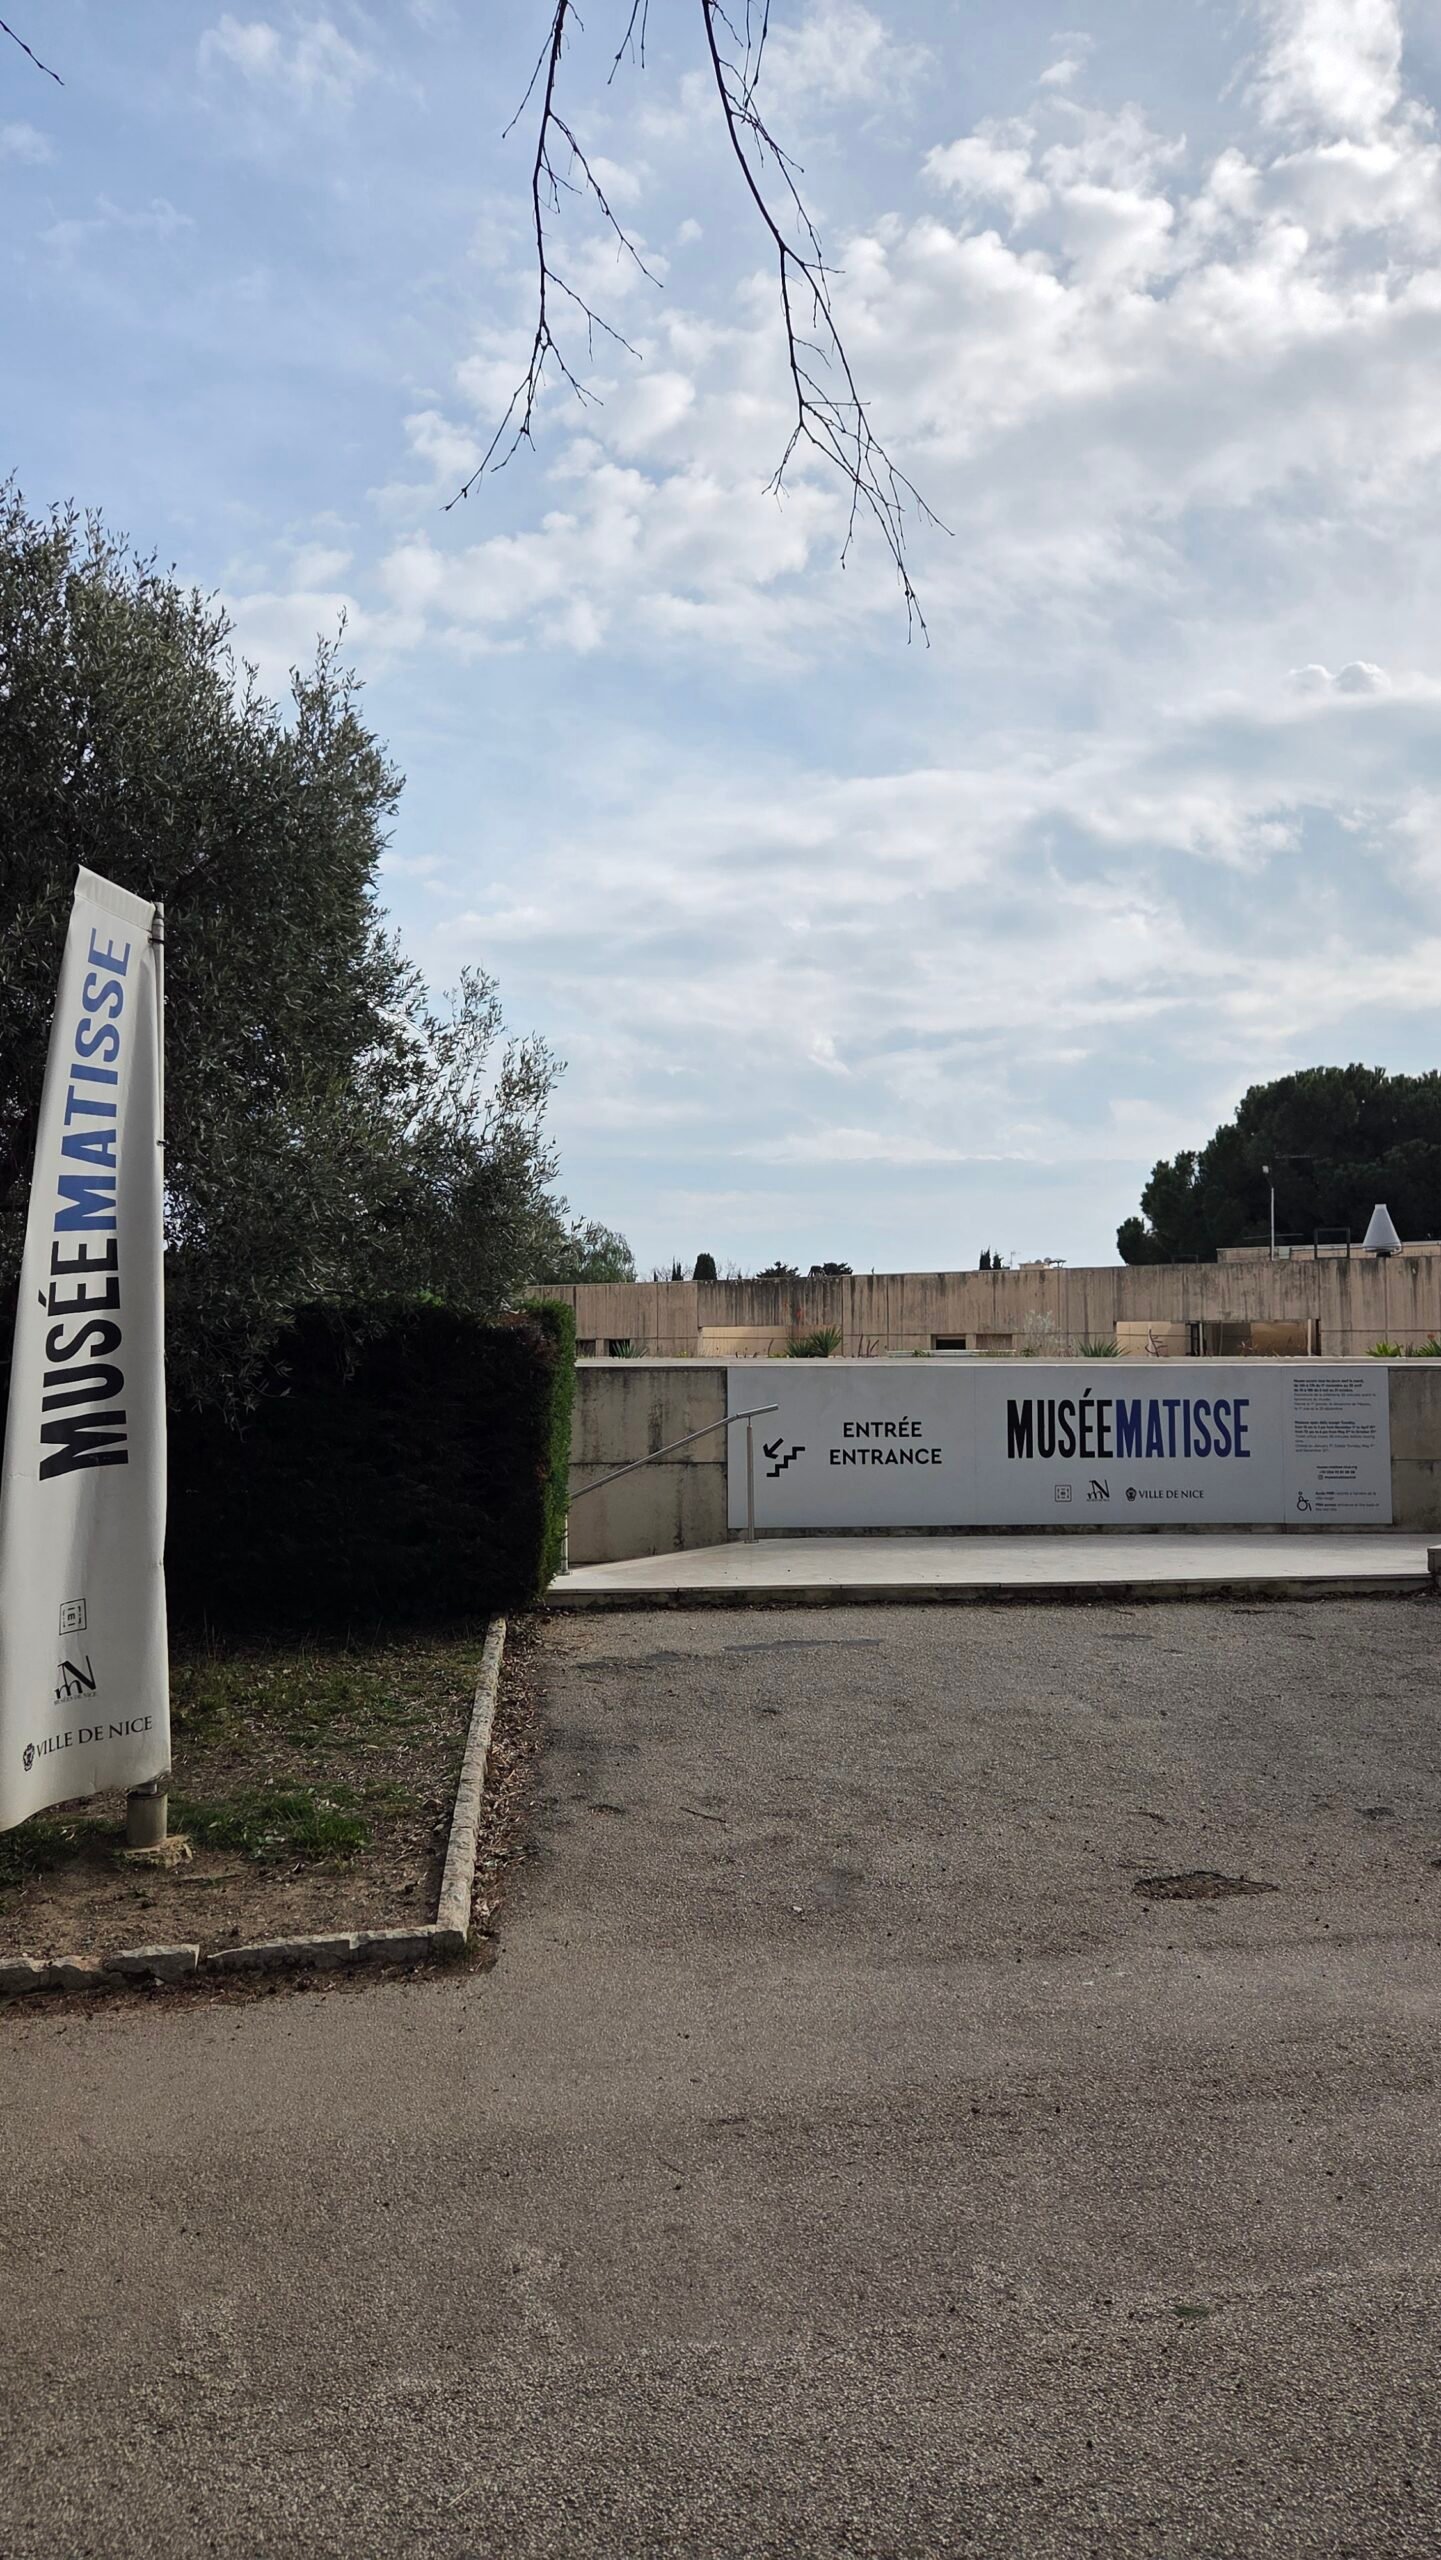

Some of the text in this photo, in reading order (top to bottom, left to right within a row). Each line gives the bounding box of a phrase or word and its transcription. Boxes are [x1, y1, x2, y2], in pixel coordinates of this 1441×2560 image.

[843, 1416, 922, 1438] ENTRÉE
[829, 1448, 942, 1465] ENTRANCE
[1138, 1489, 1205, 1499] VILLE DE NICE
[36, 1716, 153, 1758] VILLE DE NICE
